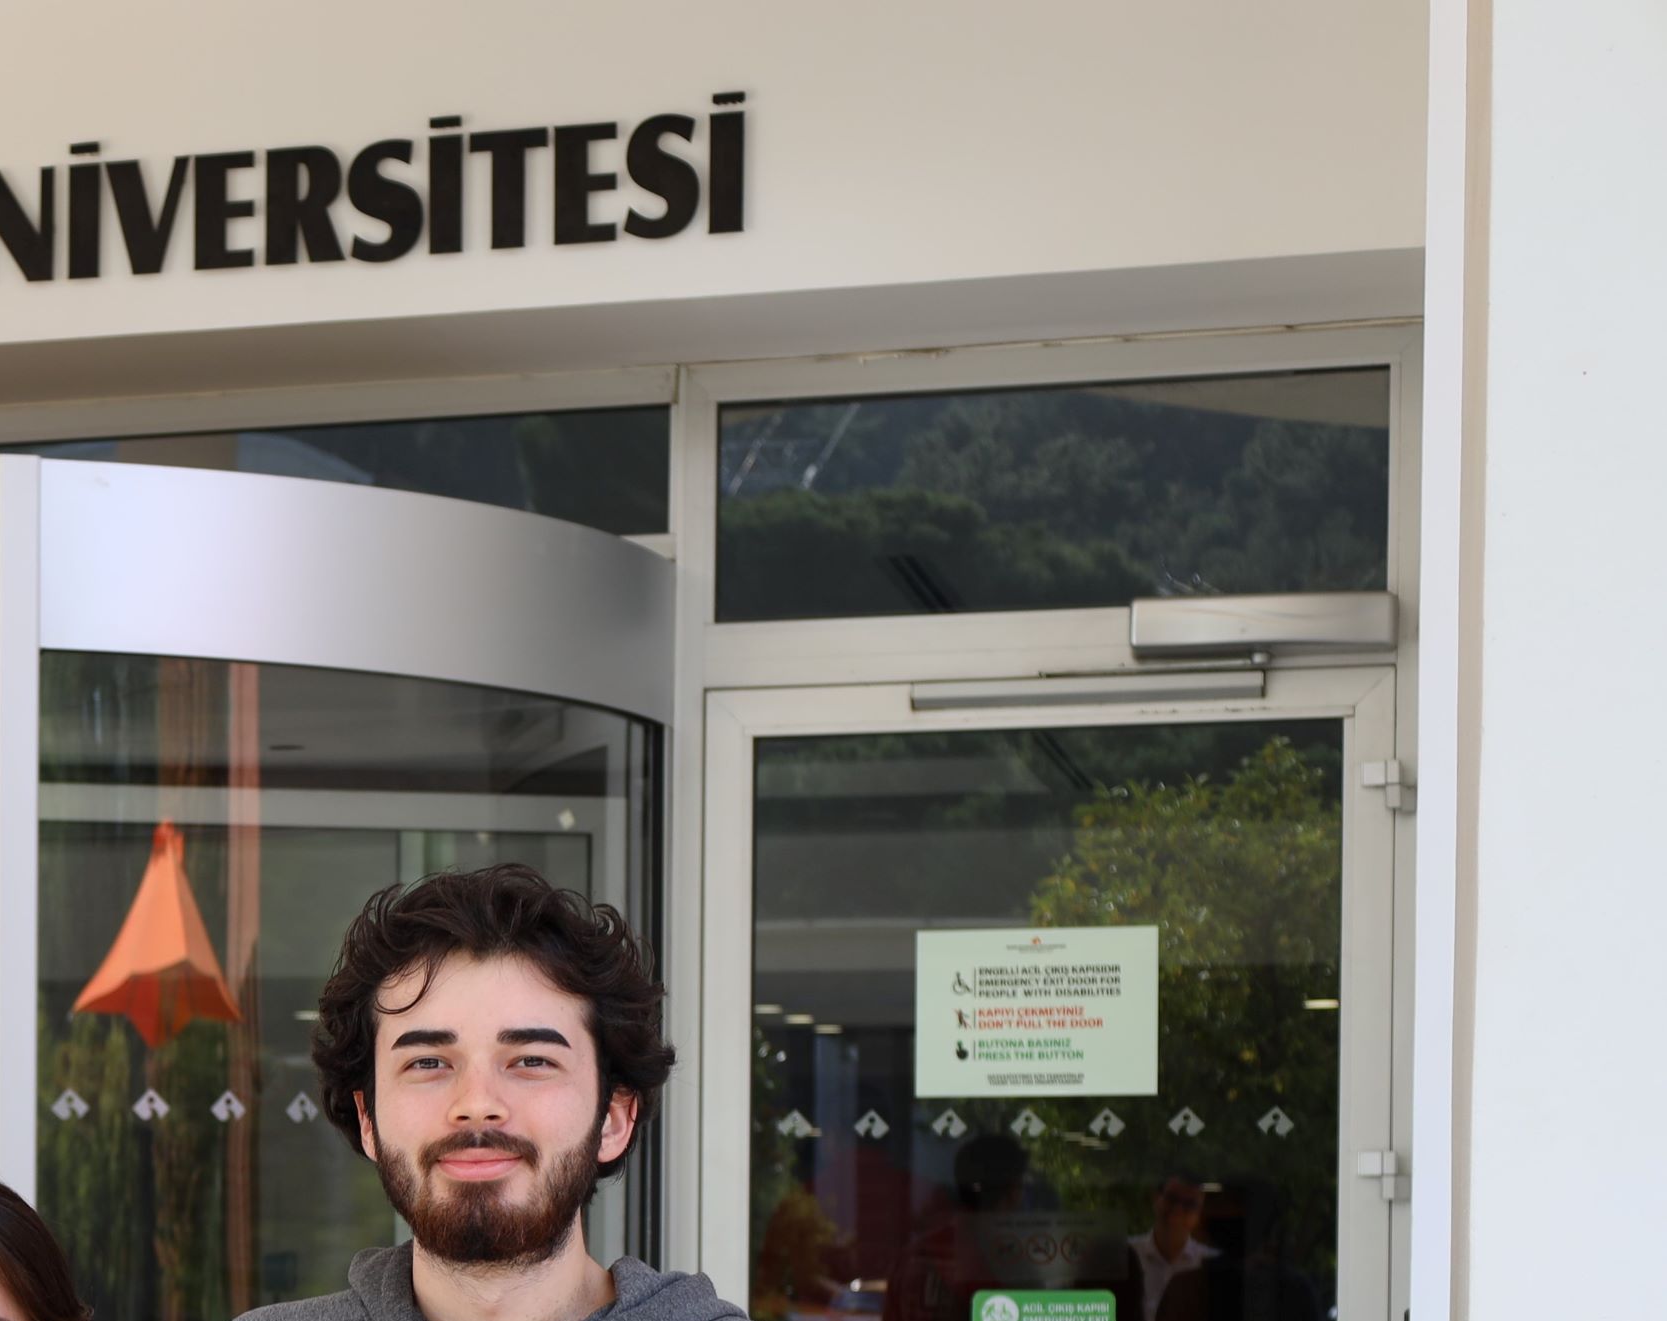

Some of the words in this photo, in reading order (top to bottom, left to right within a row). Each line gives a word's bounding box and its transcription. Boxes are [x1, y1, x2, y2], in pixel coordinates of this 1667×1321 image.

[979, 965, 1019, 976] ENGELLİ
[1021, 964, 1041, 975] ACİL
[1045, 964, 1069, 977] ÇIKIŞ
[1071, 963, 1121, 974] KAPISIDIR
[979, 976, 1039, 987] EMERGENCY
[1043, 976, 1064, 986] EXIT
[1067, 975, 1097, 985] DOOR
[1100, 975, 1121, 985] FOR
[979, 989, 1016, 998] PEOPLE
[1023, 988, 1051, 998] WITH
[1055, 987, 1121, 997] DISABILITIES
[978, 1007, 1015, 1018] KAPIYI
[1017, 1005, 1085, 1019] ÇEKMEYİNİZ
[1016, 1019, 1042, 1029] PULL
[1046, 1018, 1066, 1029] THE
[1070, 1018, 1103, 1028] DOOR
[978, 1039, 1024, 1049] BUTONA
[1027, 1038, 1071, 1048] BASINIZ
[978, 1051, 1012, 1061] PRESS
[1015, 1051, 1034, 1060] THE
[1038, 1050, 1084, 1060] BUTTON
